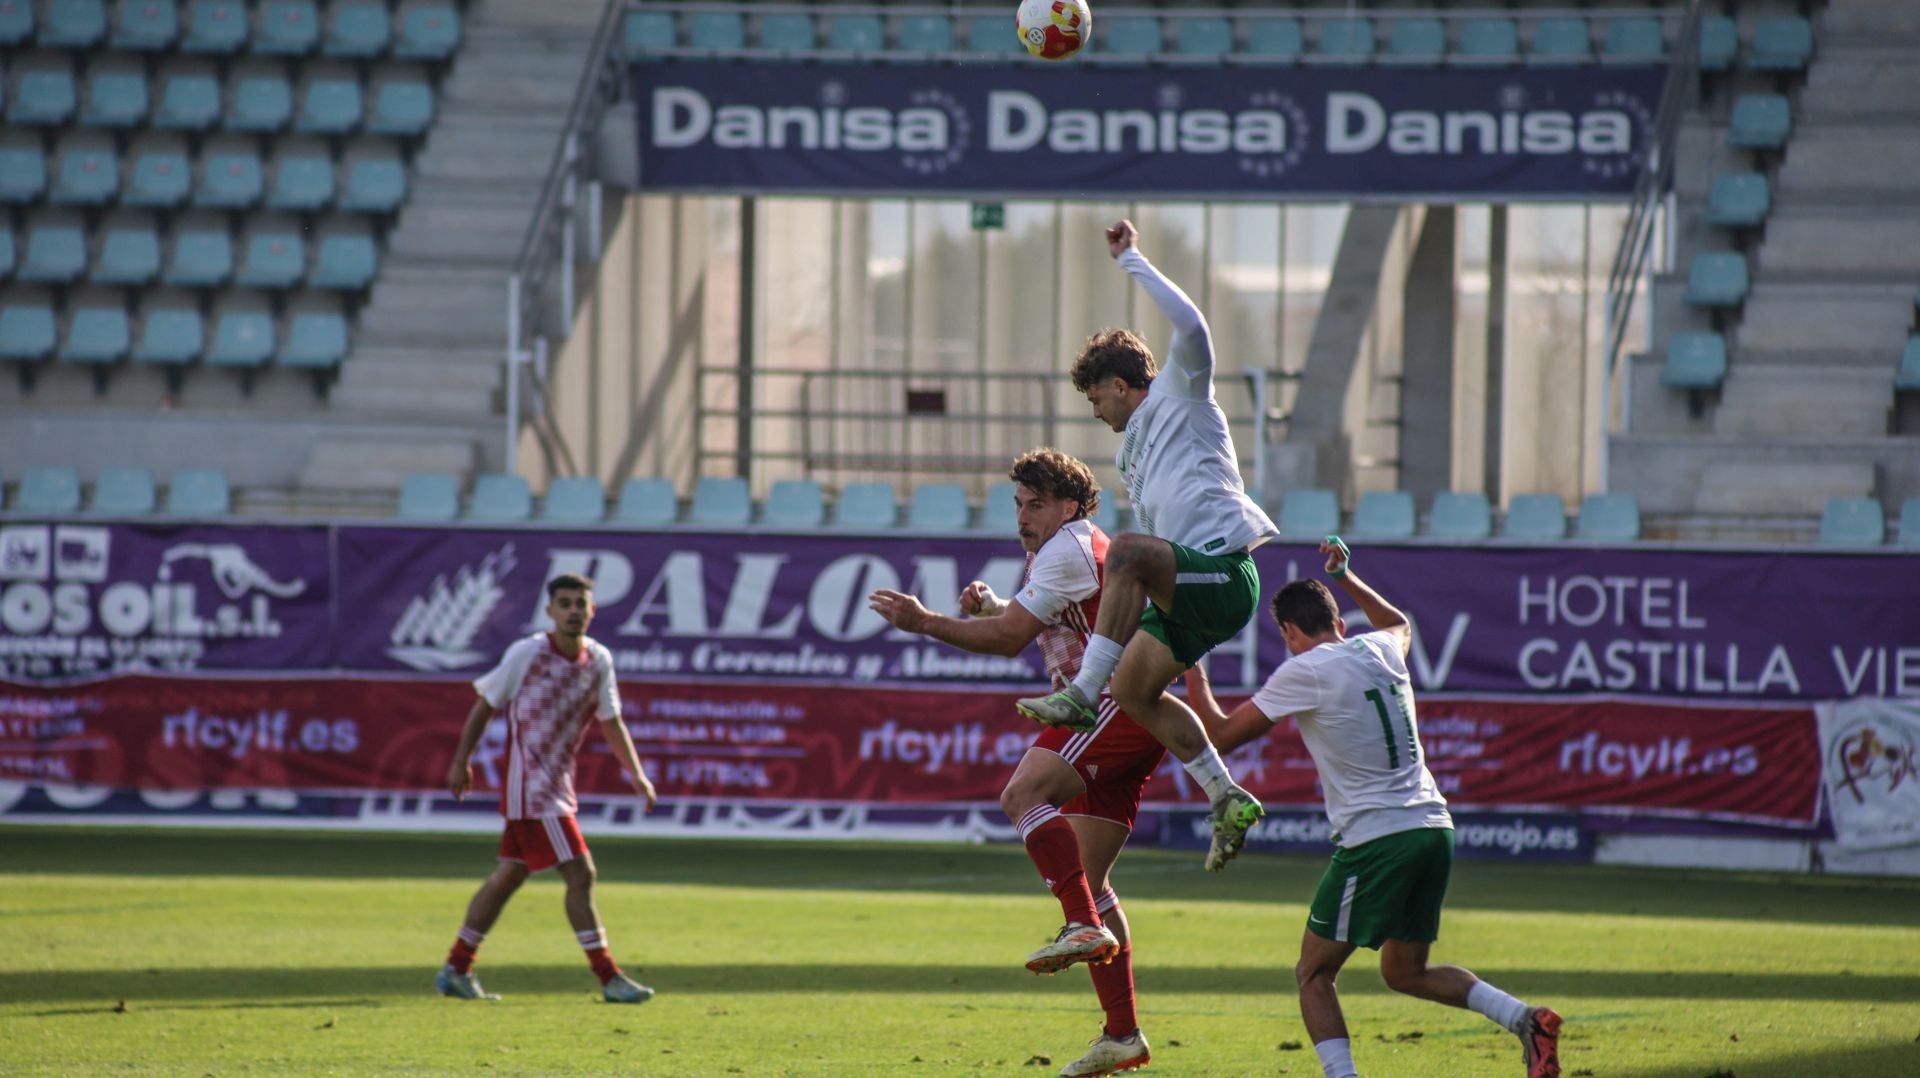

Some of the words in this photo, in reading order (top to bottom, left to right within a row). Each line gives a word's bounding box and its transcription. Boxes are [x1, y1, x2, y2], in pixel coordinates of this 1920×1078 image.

[652, 83, 948, 151] Danisa
[987, 85, 1287, 153] Danisa
[1325, 88, 1632, 154] Danisa
[524, 548, 1036, 642] PALOM
[1519, 575, 1707, 629] HOTEL
[689, 642, 847, 674] Cereales
[854, 654, 883, 681] y
[1517, 638, 1801, 695] CASTILLA
[162, 705, 359, 758] rfcylf.es
[1560, 732, 1758, 783] rfcylf.es
